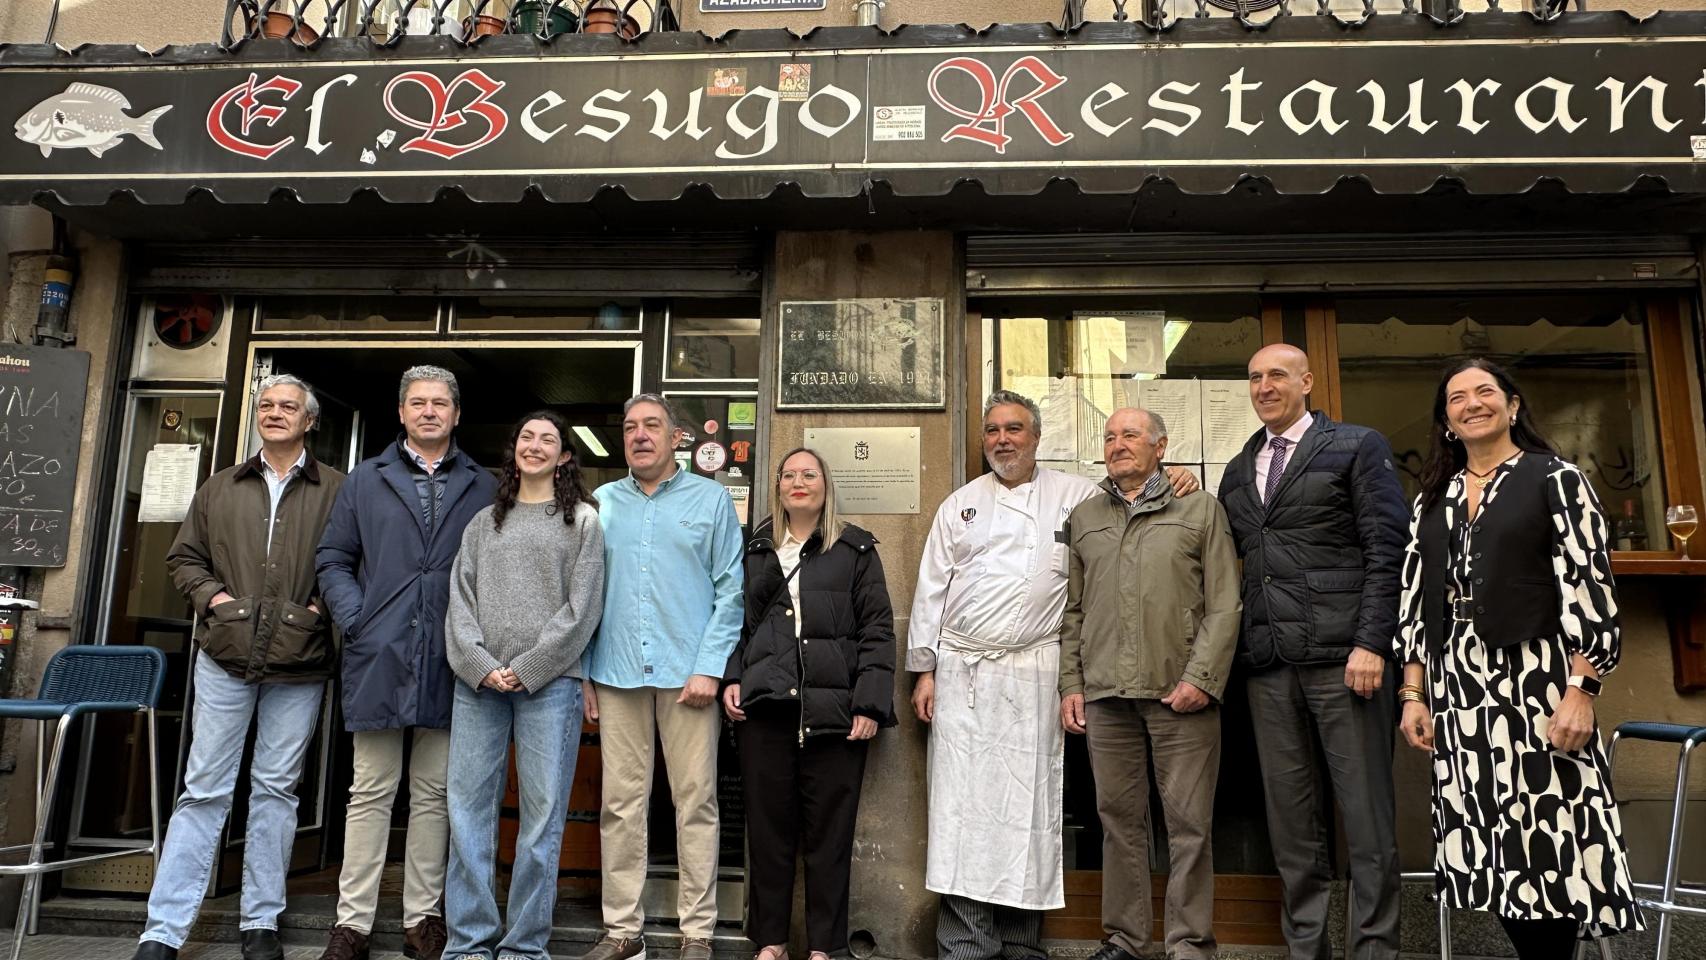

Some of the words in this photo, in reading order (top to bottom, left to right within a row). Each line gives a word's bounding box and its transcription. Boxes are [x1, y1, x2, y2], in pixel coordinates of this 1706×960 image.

[206, 72, 358, 160] El
[382, 68, 862, 161] Besugo
[789, 371, 859, 385] FUNDADO
[0, 385, 59, 418] NA
